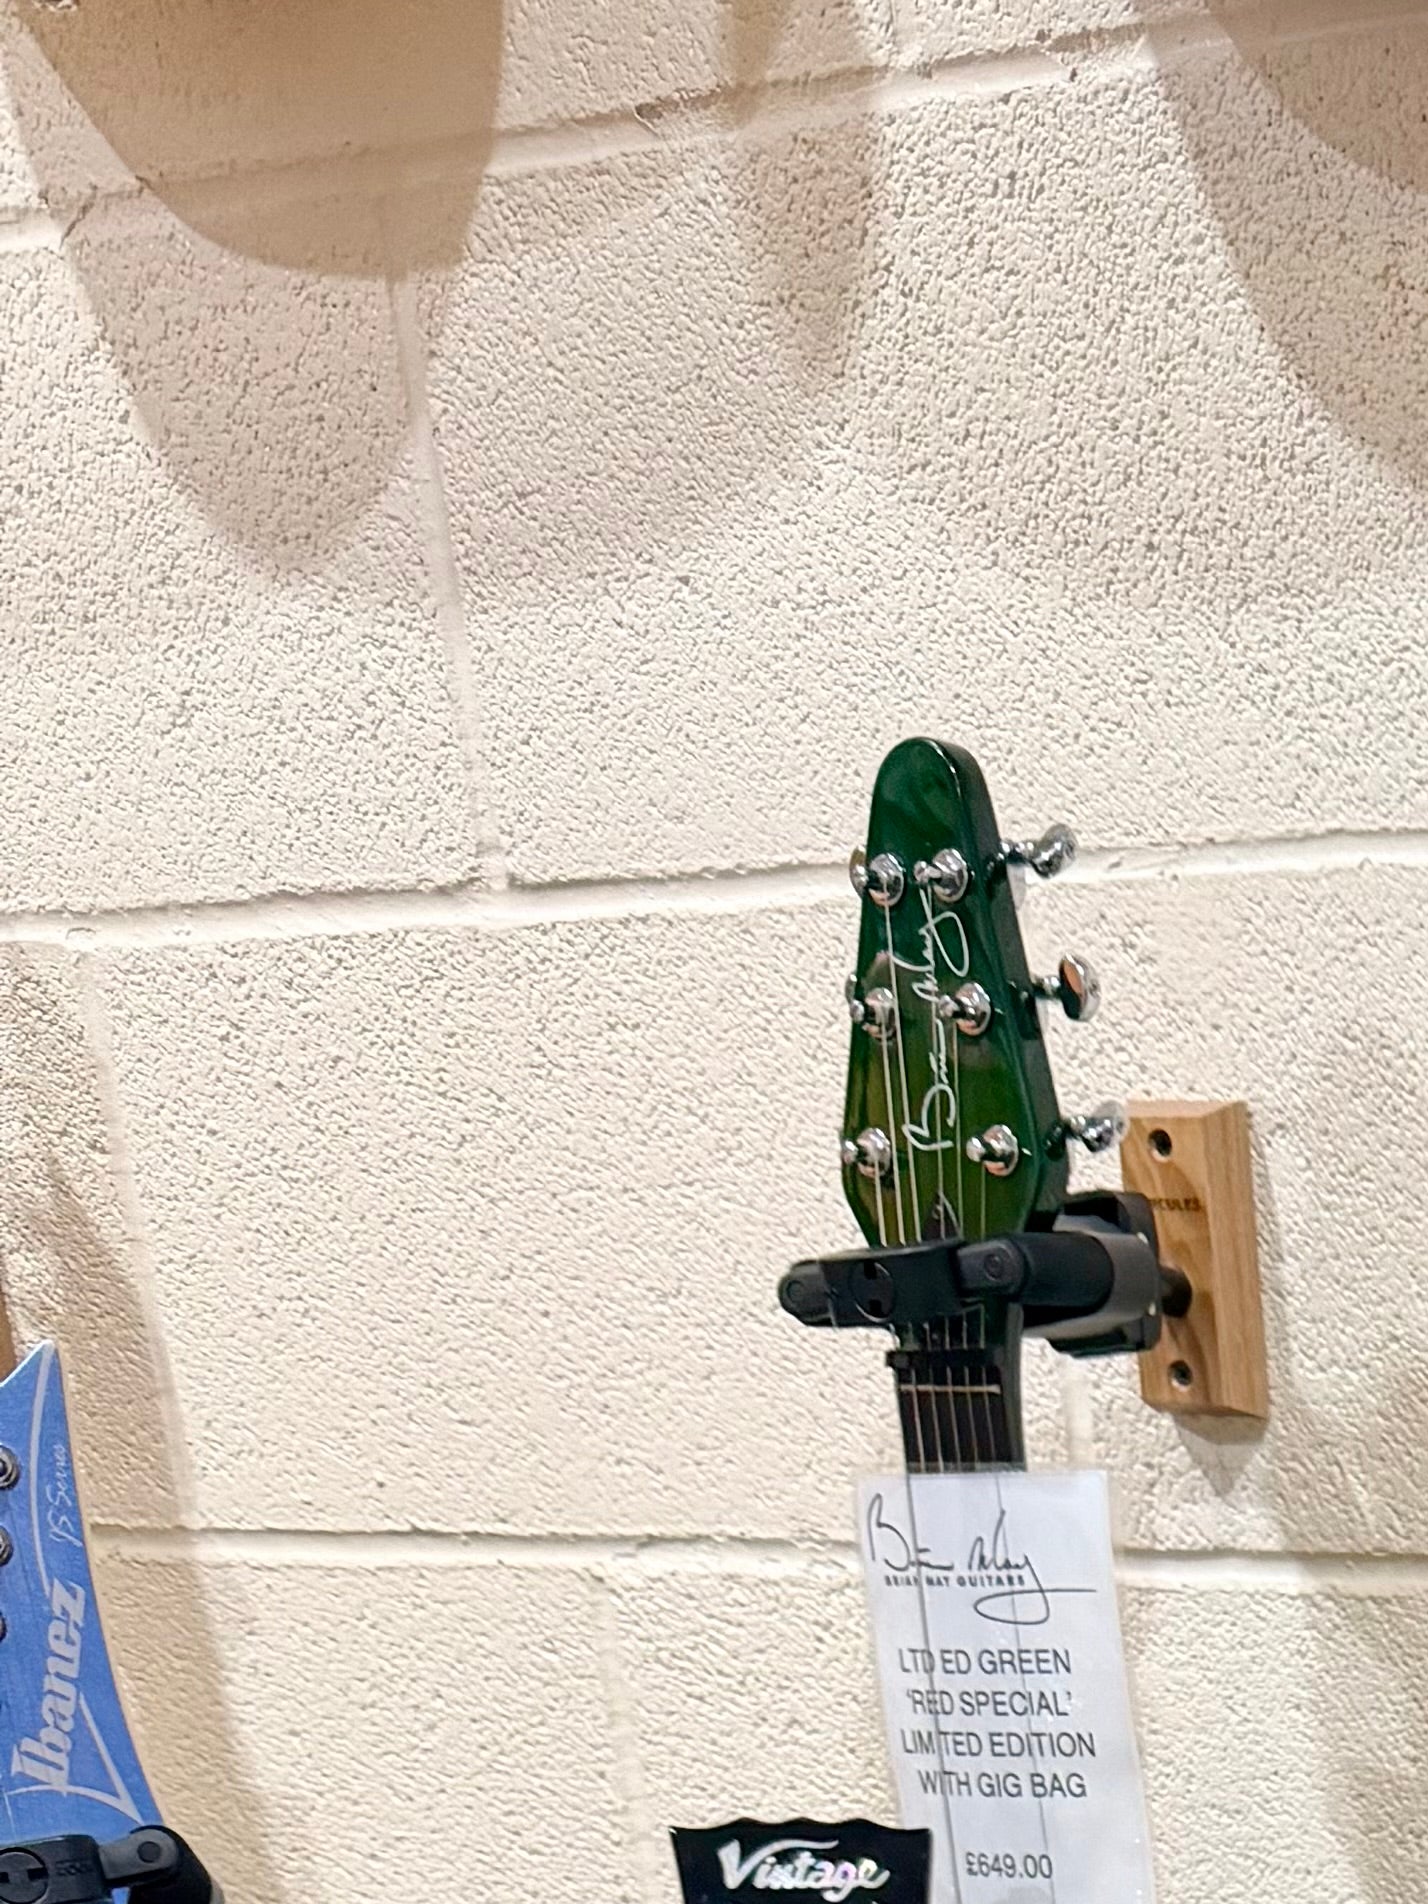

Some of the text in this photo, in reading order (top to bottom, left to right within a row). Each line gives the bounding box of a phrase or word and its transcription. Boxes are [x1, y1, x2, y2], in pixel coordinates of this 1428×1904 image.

[957, 1574, 1025, 1587] GUITARS
[899, 1648, 1071, 1675] LTD ED GREEN
[11, 1577, 85, 1797] Ibanez
[901, 1729, 1096, 1758] LIMTED EDITION
[918, 1770, 1087, 1798] WITH GIG BAG
[717, 1839, 891, 1902] Vintage
[966, 1852, 1053, 1879] £649.00
